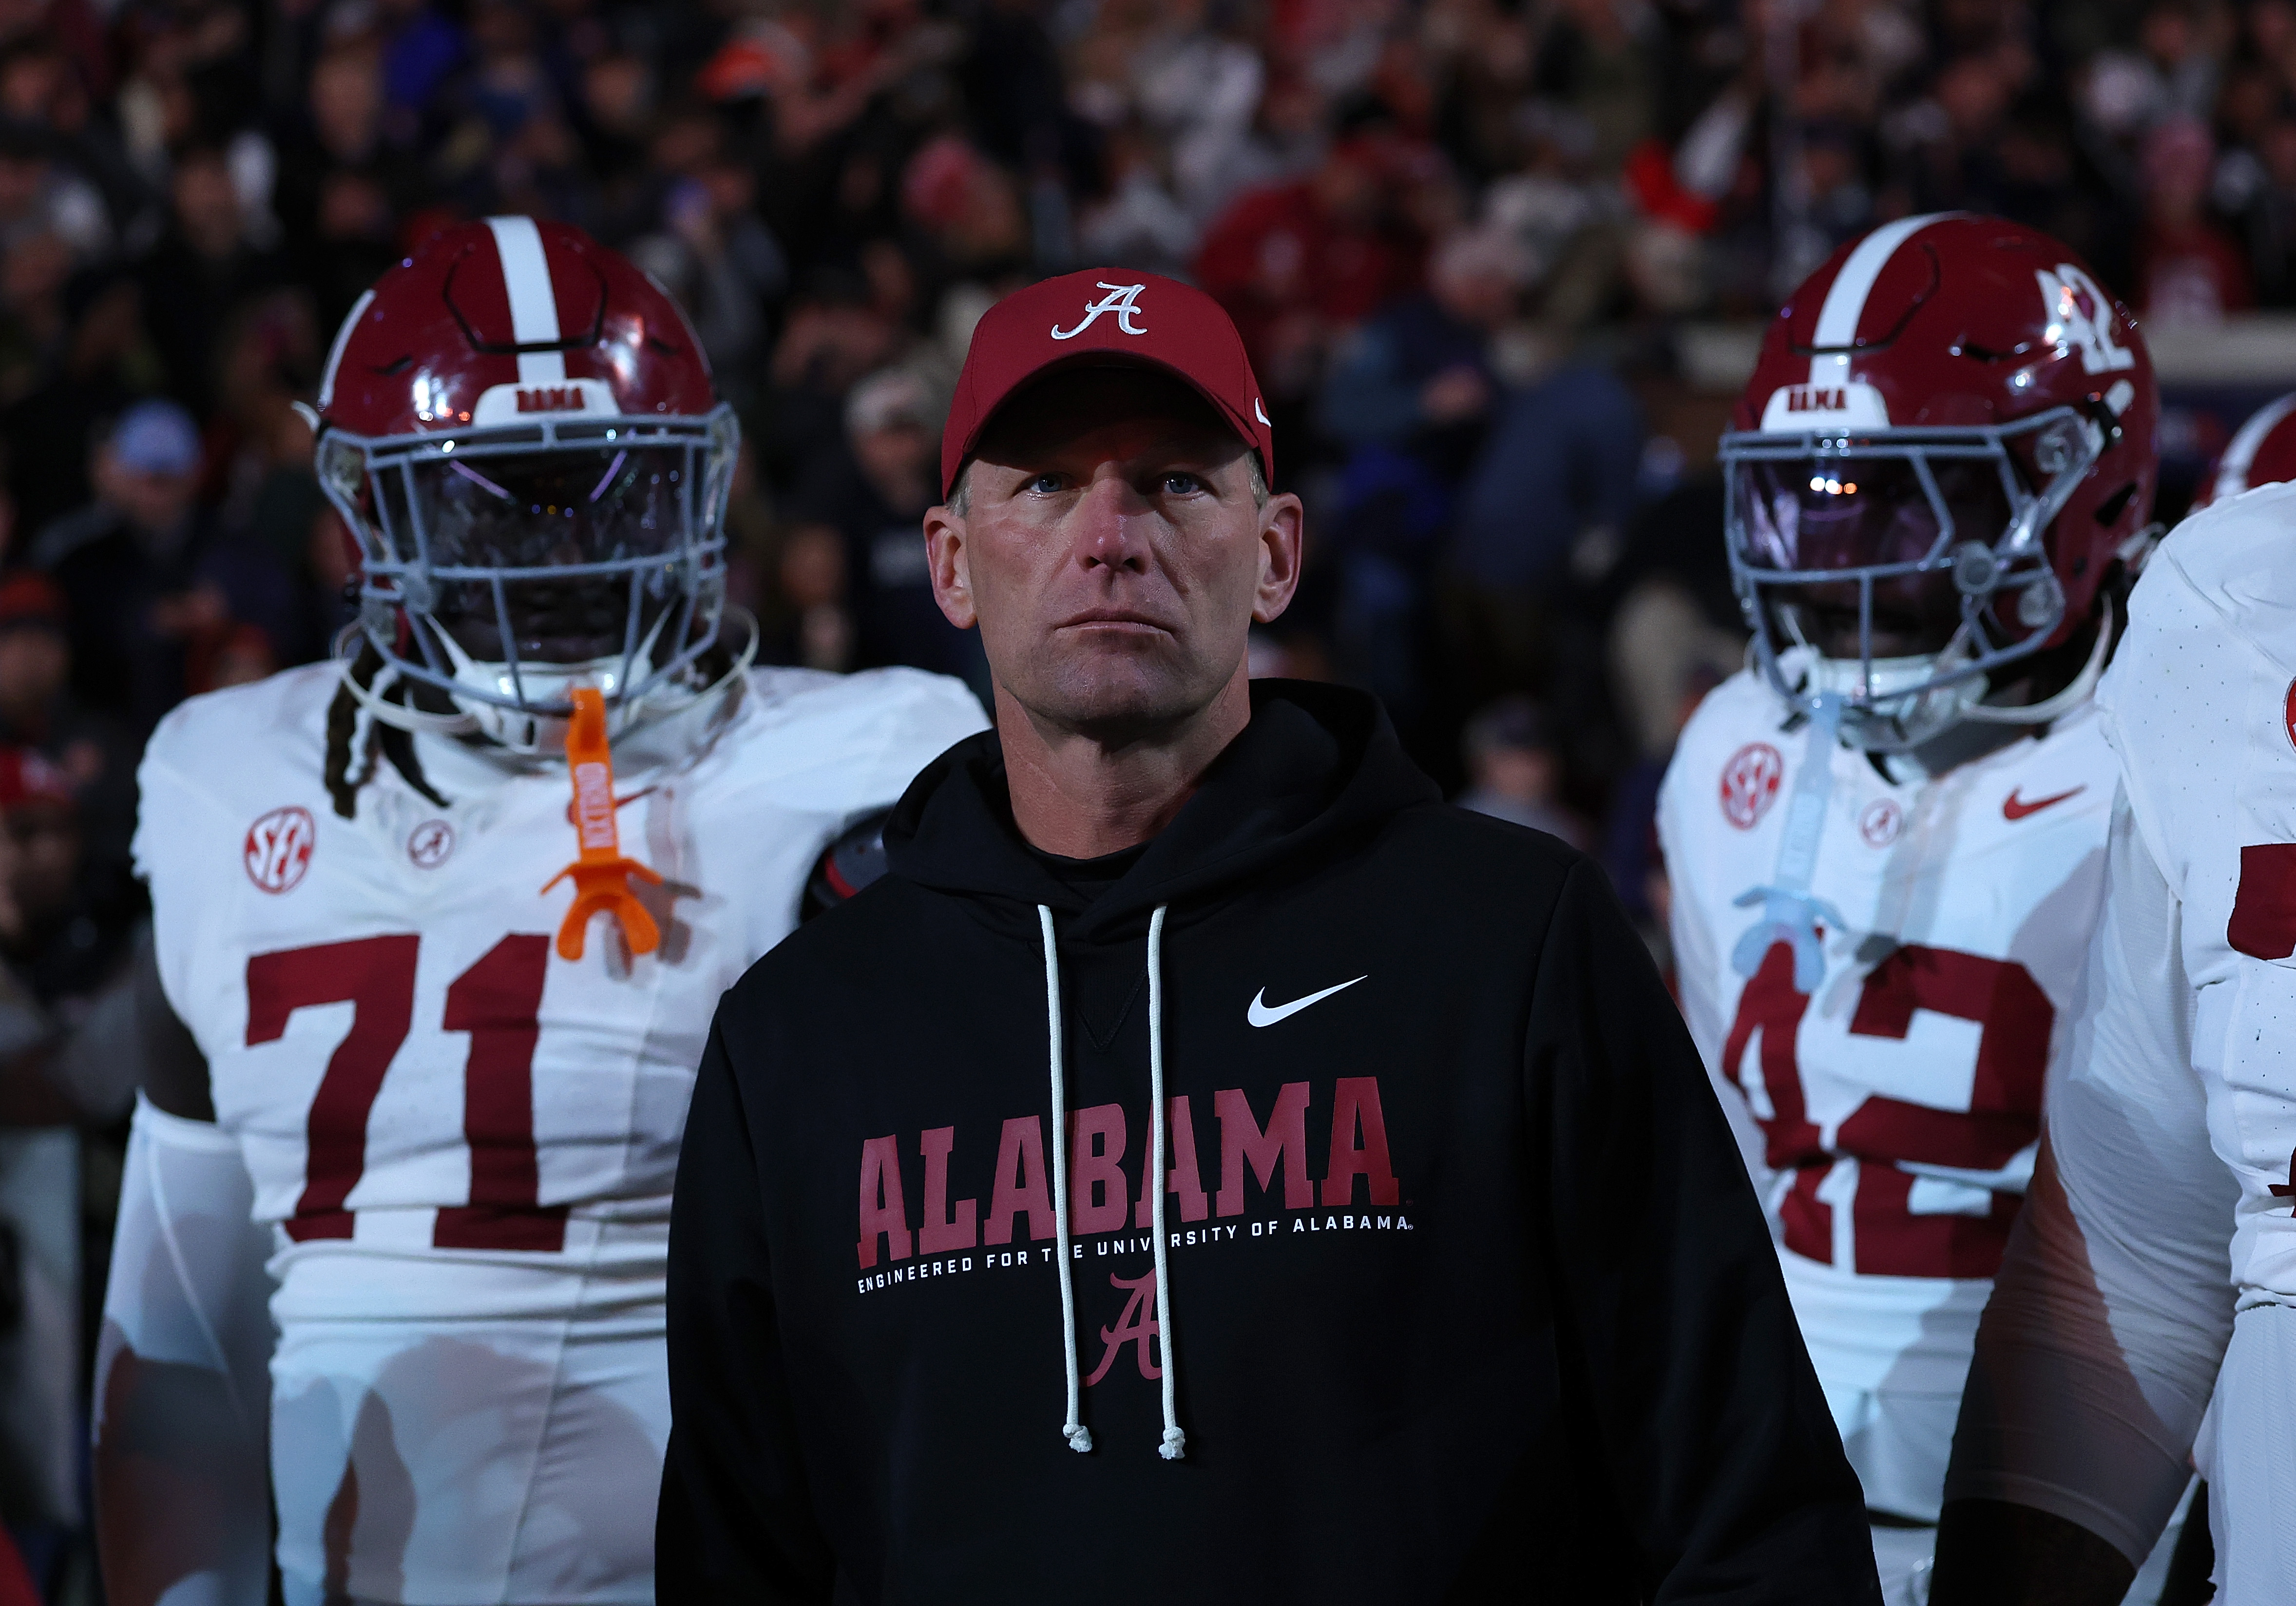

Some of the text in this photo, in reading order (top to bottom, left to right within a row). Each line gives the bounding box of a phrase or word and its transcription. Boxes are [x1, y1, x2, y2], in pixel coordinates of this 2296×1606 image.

[1051, 281, 1148, 340] A
[246, 933, 569, 1252] 71
[1723, 933, 2055, 1279] 42
[856, 1075, 1399, 1270] ALABAMA
[858, 1257, 972, 1294] ENGINEERED
[987, 1251, 1028, 1268] FOR
[1042, 1244, 1083, 1262] TE
[1097, 1224, 1237, 1256] UNIVRSITY
[1251, 1220, 1278, 1237] OF
[1078, 1266, 1163, 1388] A
